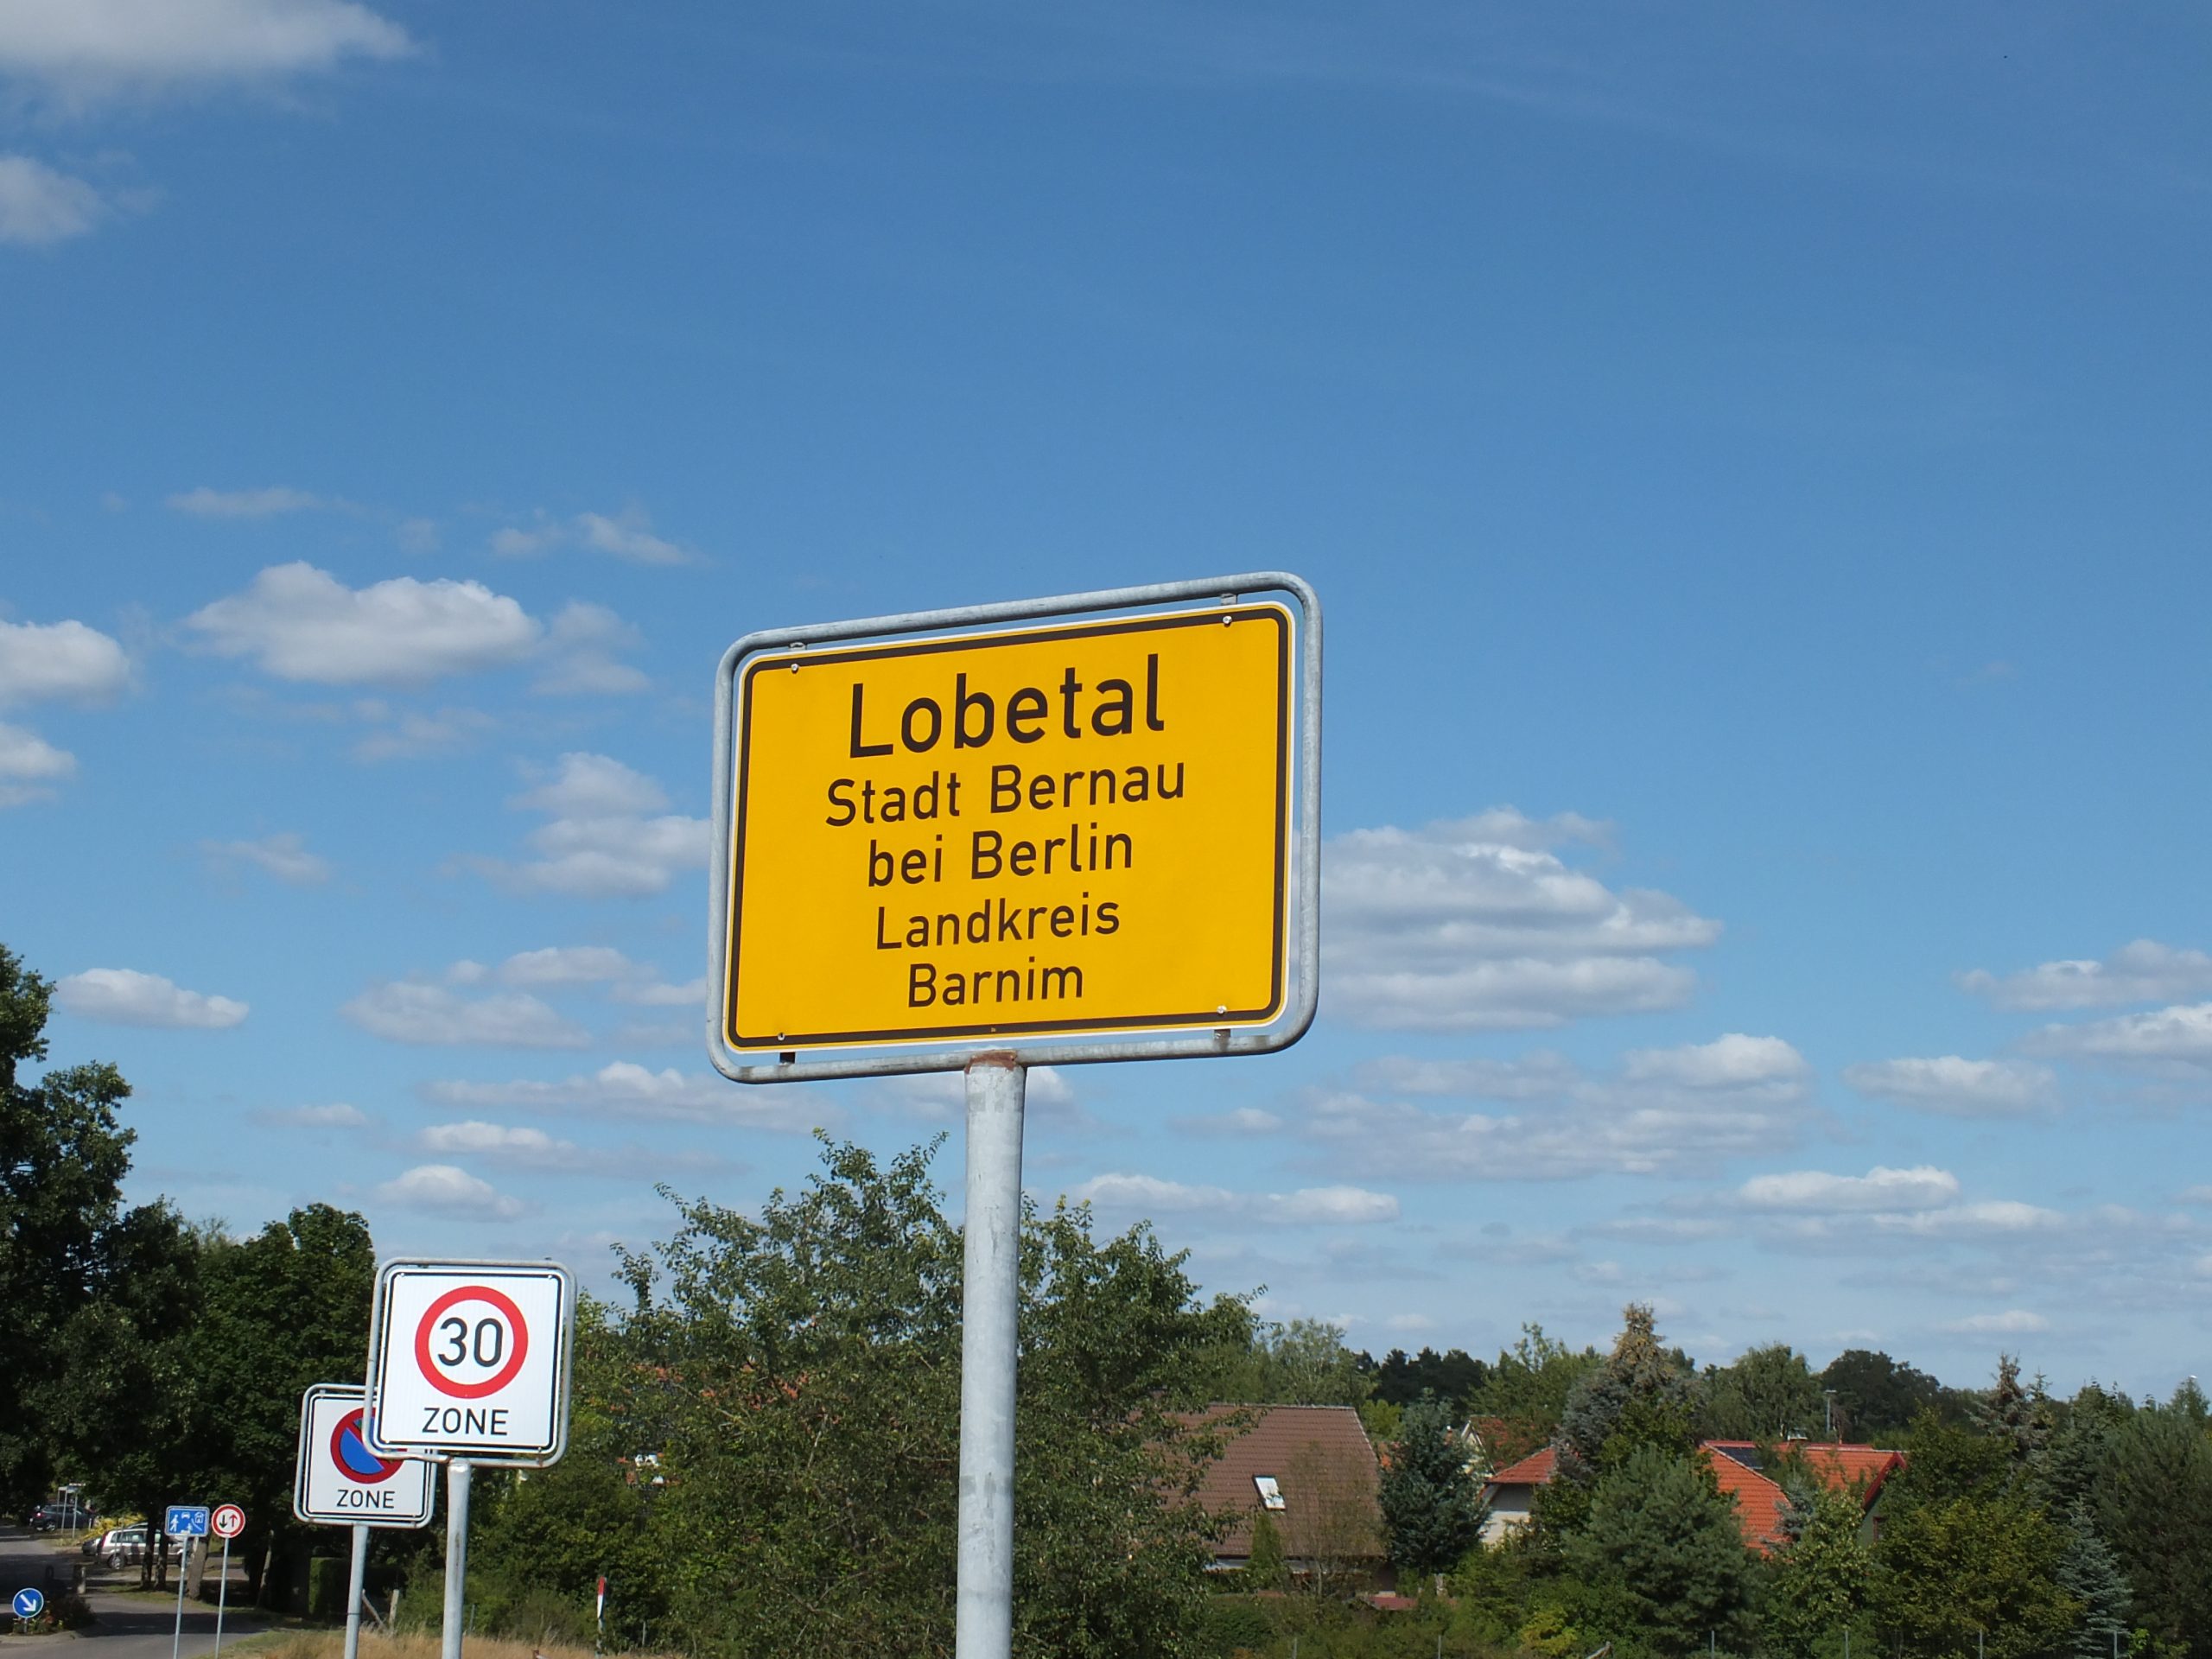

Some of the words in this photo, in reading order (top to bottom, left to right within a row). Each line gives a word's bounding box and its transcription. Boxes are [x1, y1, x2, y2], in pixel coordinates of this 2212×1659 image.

[849, 653, 1165, 759] Lobetal
[825, 770, 961, 827] Stadt
[990, 762, 1185, 813] Bernau
[868, 834, 943, 887] bei
[970, 822, 1133, 880] Berlin
[876, 891, 1120, 950] Landkreis
[908, 956, 1084, 1008] Barnim
[437, 1317, 504, 1368] 30
[422, 1408, 508, 1435] ZONE
[336, 1489, 396, 1509] ZONE
